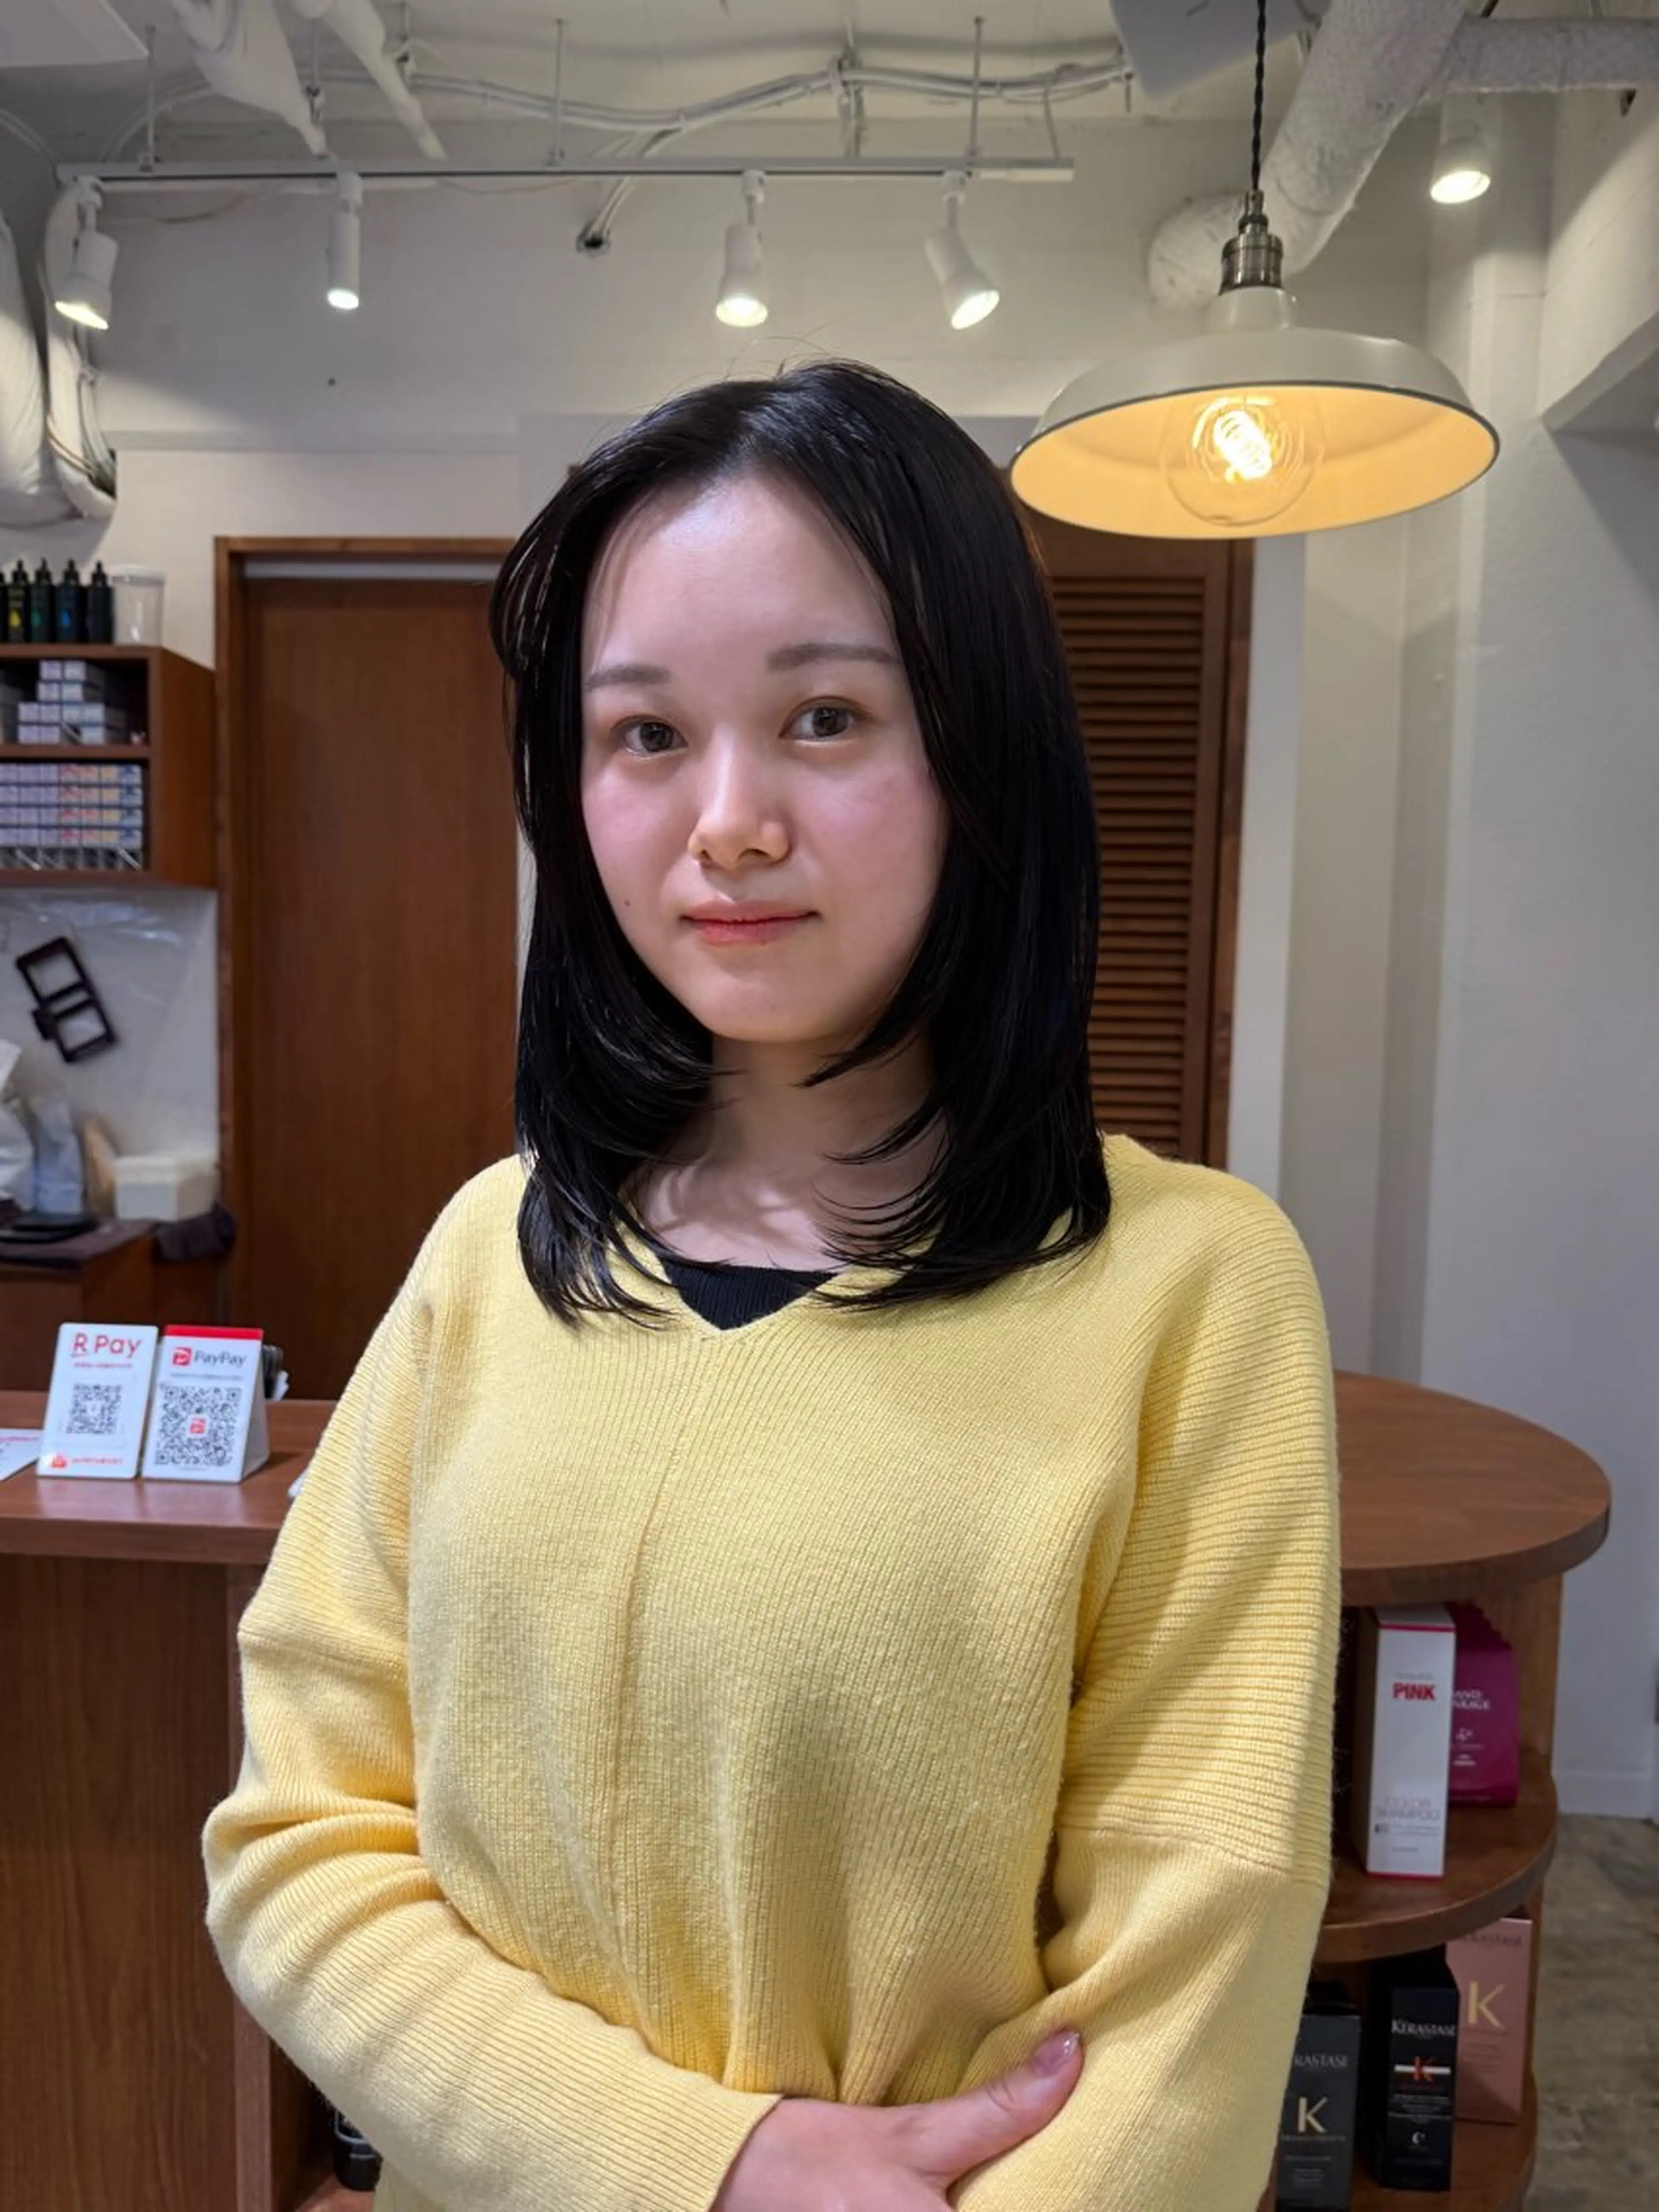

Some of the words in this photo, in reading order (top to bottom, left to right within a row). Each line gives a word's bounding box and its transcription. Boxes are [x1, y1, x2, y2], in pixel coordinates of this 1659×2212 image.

[73, 1332, 89, 1356] R
[94, 1334, 142, 1359] Pay
[194, 1350, 247, 1368] PayPay
[1392, 1682, 1436, 1701] PINK
[1468, 1980, 1505, 2028] K
[1298, 2096, 1329, 2133] K
